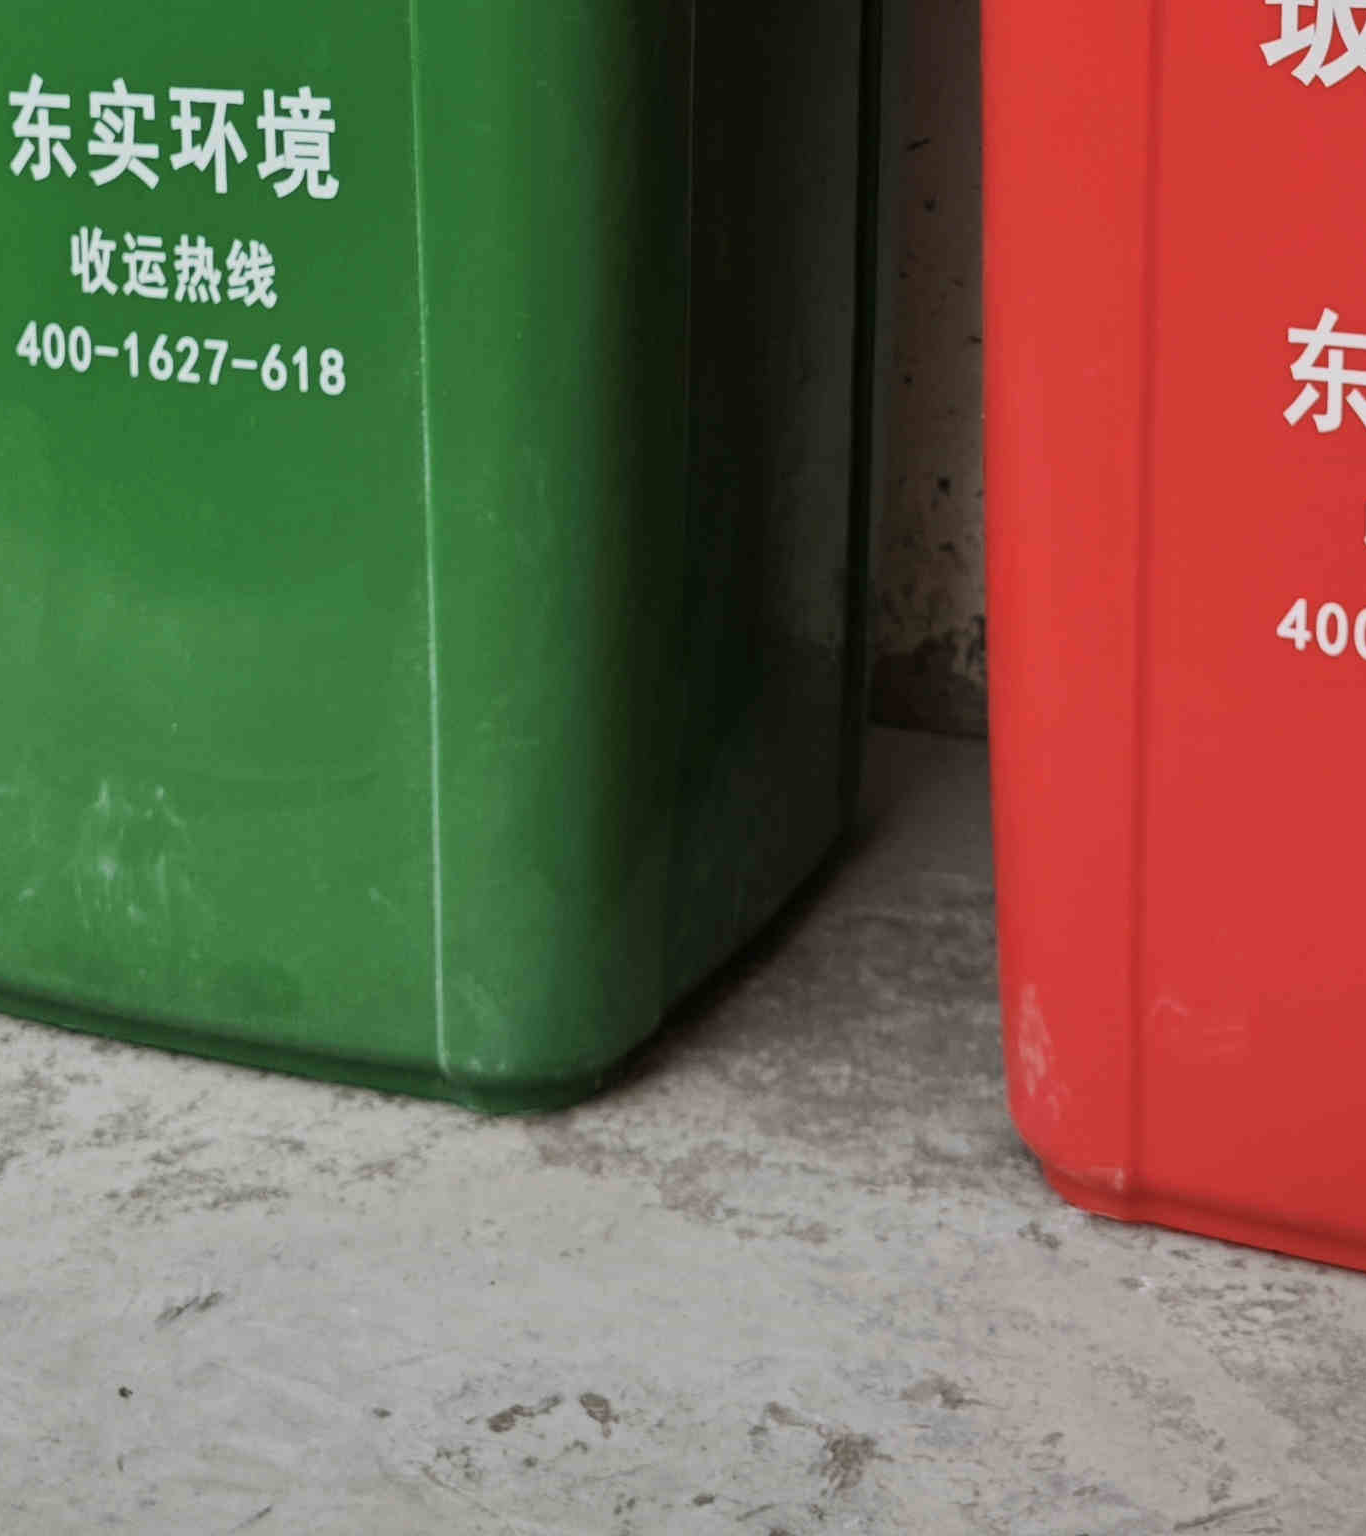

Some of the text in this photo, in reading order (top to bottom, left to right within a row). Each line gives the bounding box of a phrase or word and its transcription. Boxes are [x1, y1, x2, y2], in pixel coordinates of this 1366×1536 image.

[8, 72, 341, 200] 东实环境
[70, 225, 278, 310] 收运热线
[16, 320, 347, 396] 400-1627-618
